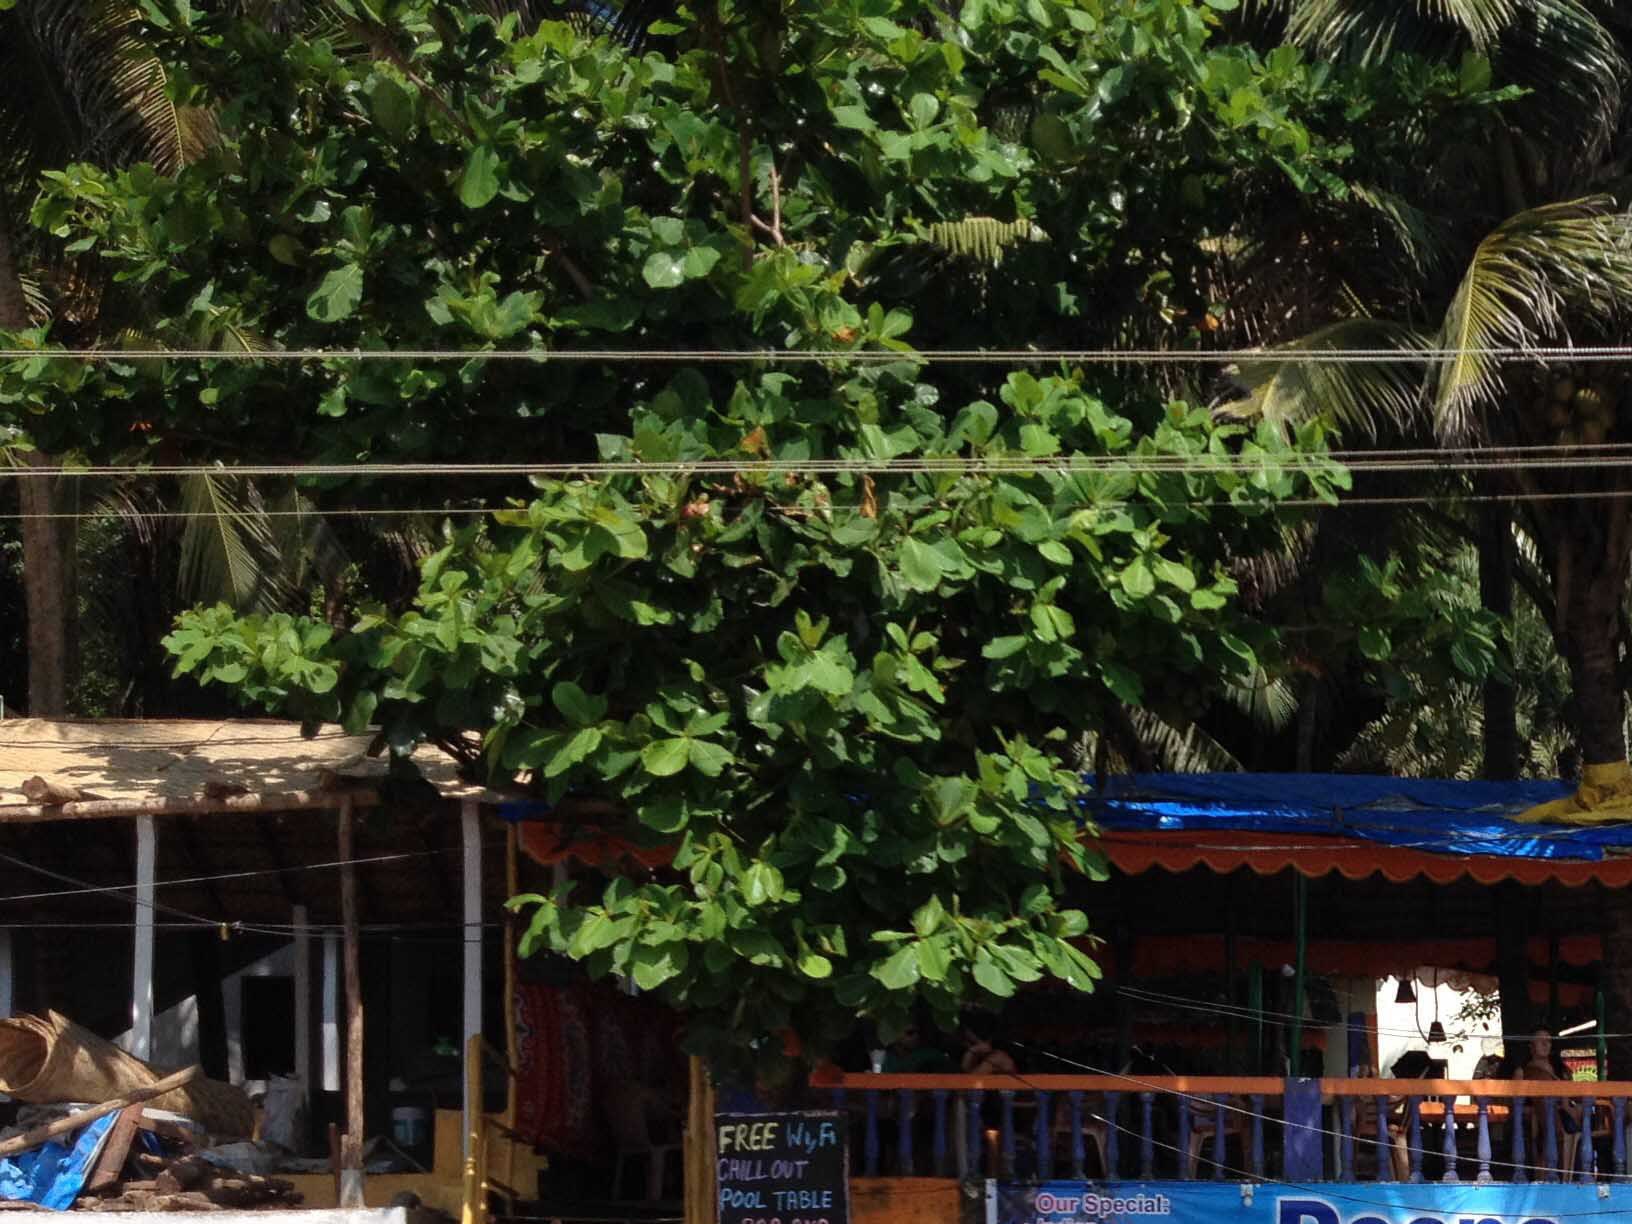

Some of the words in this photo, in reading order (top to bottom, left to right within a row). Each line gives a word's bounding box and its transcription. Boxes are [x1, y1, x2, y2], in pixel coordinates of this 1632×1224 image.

[719, 1121, 779, 1154] FREE
[717, 1157, 768, 1182] CHILL
[770, 1159, 809, 1180] OUT
[719, 1188, 768, 1211] POOL
[772, 1190, 833, 1210] TABLE
[1034, 1193, 1079, 1214] Our
